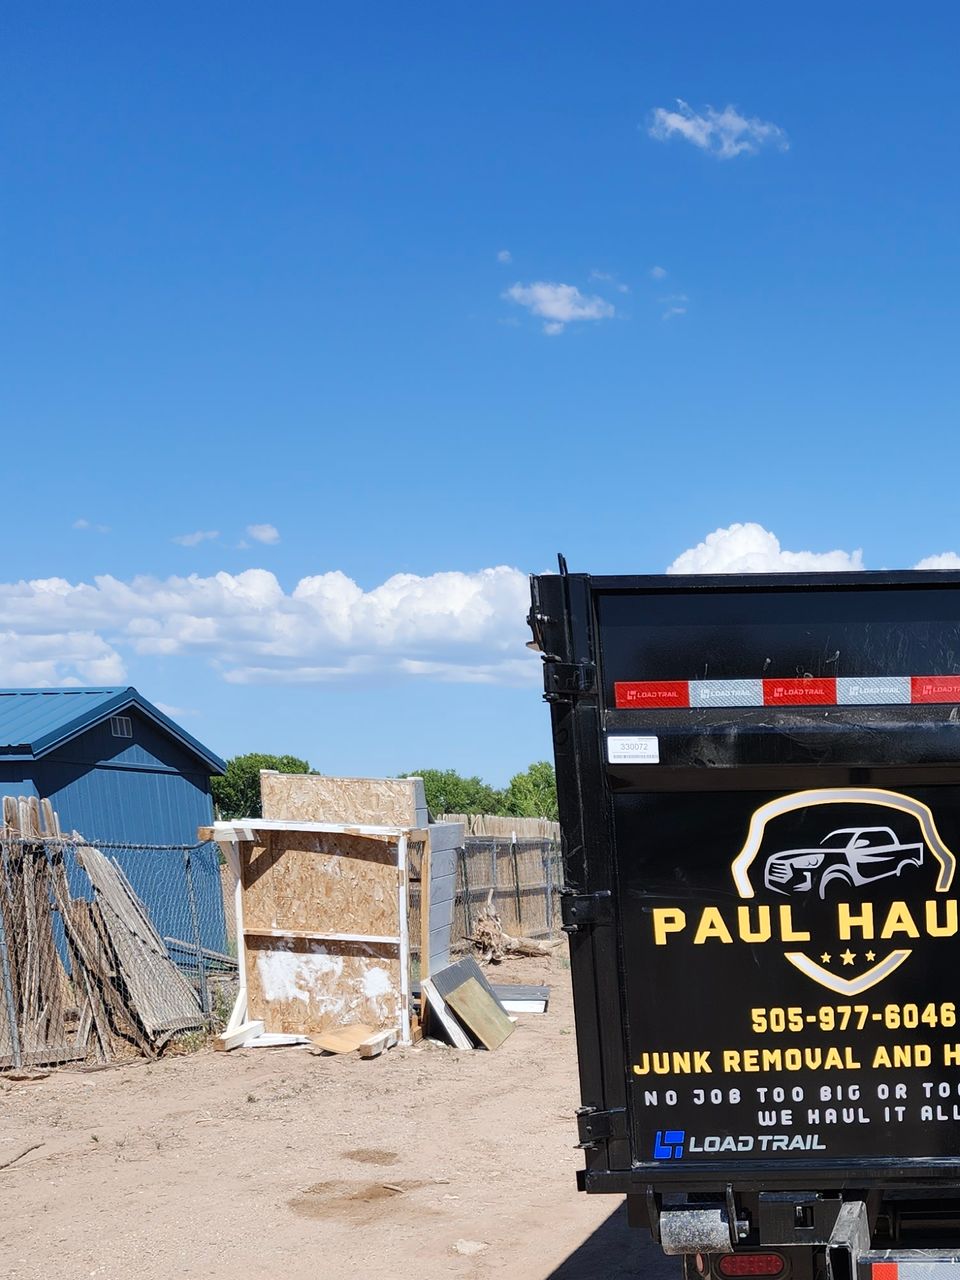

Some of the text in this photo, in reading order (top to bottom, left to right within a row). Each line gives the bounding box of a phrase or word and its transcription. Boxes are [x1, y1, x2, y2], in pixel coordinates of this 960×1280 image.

[653, 904, 811, 946] PAUL
[751, 1002, 957, 1033] 505-977-6046
[633, 1050, 713, 1075] JUNK
[722, 1046, 861, 1073] REMOVAL
[871, 1044, 932, 1069] AND
[644, 1089, 678, 1107] NO
[693, 1088, 741, 1105] JOB
[756, 1086, 804, 1104] TOO
[819, 1084, 861, 1102] BIG
[877, 1083, 908, 1100] OR
[757, 1109, 793, 1127] WE
[807, 1107, 871, 1125] HAUL
[884, 1106, 906, 1123] IT
[689, 1134, 827, 1153] LOAD TRAIL
